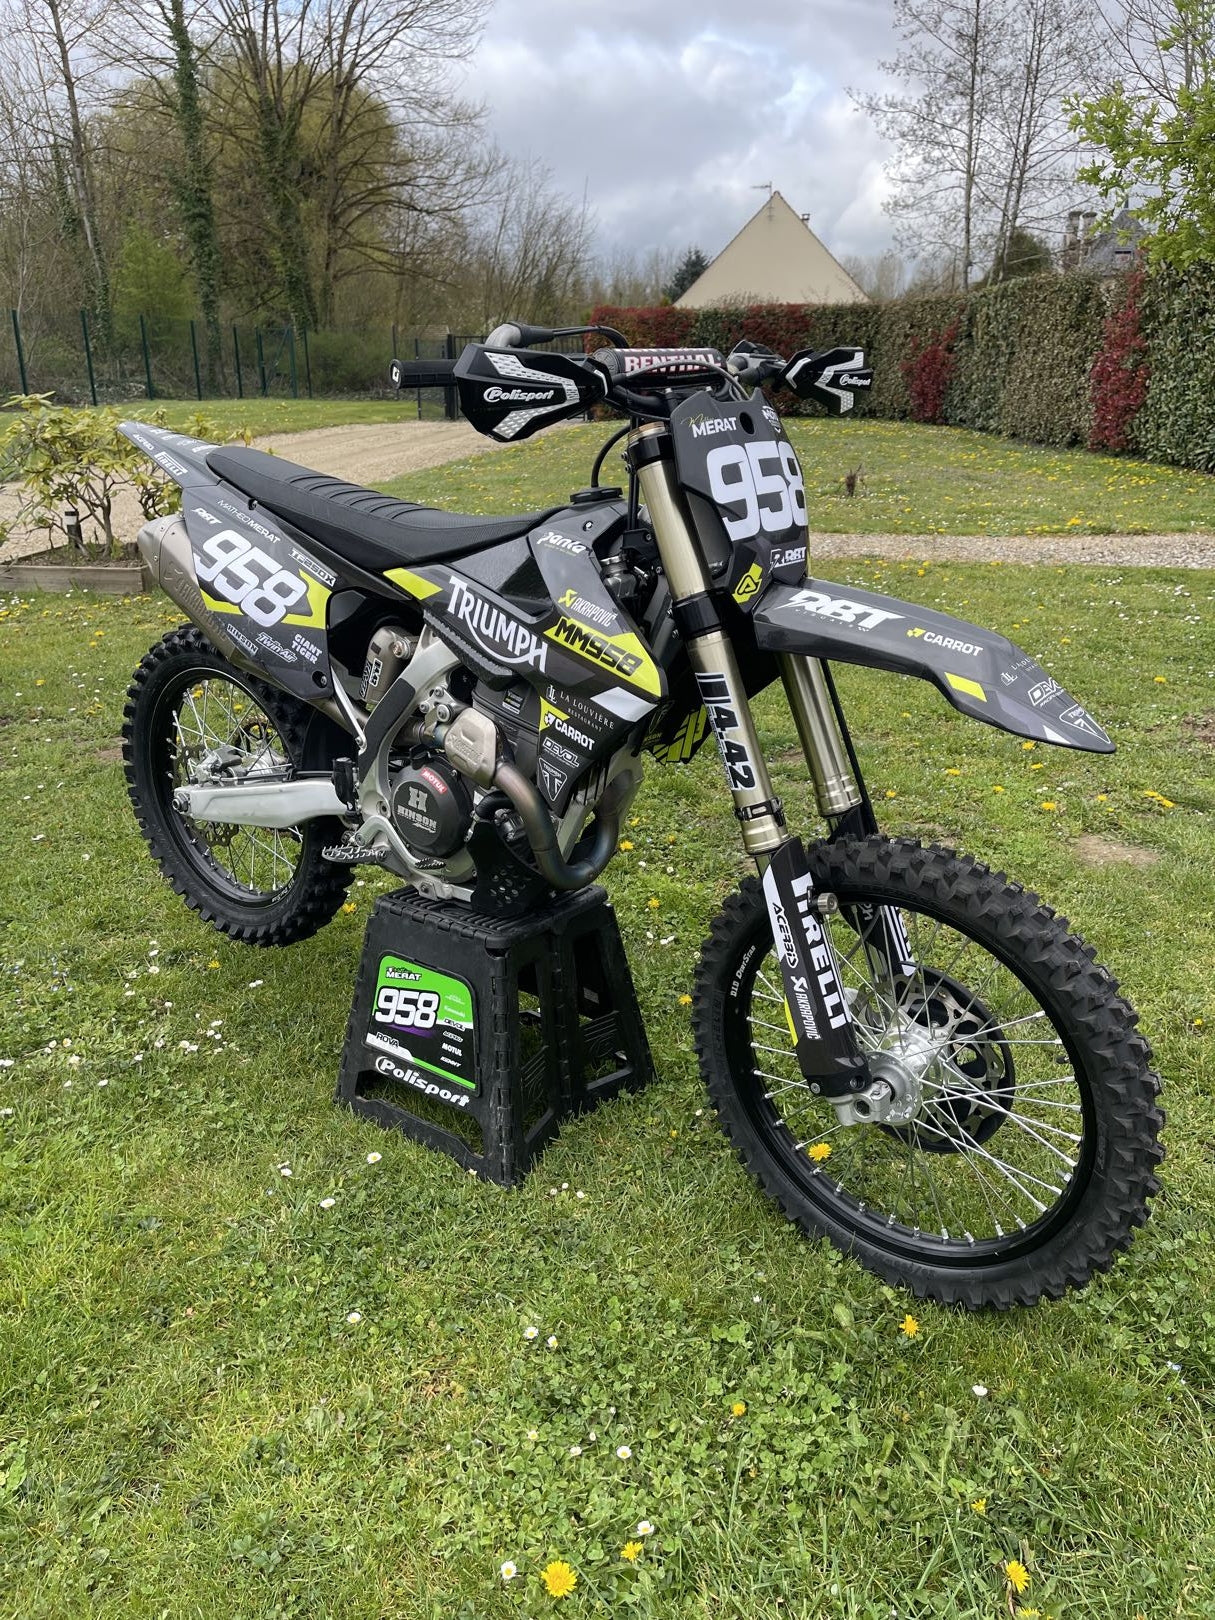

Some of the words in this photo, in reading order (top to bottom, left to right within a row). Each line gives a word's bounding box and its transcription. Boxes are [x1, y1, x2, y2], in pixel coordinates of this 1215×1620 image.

[483, 386, 554, 403] Polisport
[691, 417, 737, 438] MERAT
[154, 451, 188, 476] PIRELLI
[706, 441, 809, 541] 958
[247, 518, 281, 543] MERAT
[193, 529, 308, 628] 958
[447, 575, 549, 674] TRIUMPH
[291, 641, 318, 664] TIGER
[294, 634, 322, 655] GIANT
[554, 618, 644, 677] MM958
[923, 631, 984, 657] CARROT
[555, 718, 595, 751] CARROT
[397, 804, 437, 829] HINSON
[386, 971, 422, 981] MERAT
[375, 987, 439, 1029] 958
[375, 1056, 470, 1107] Polisport
